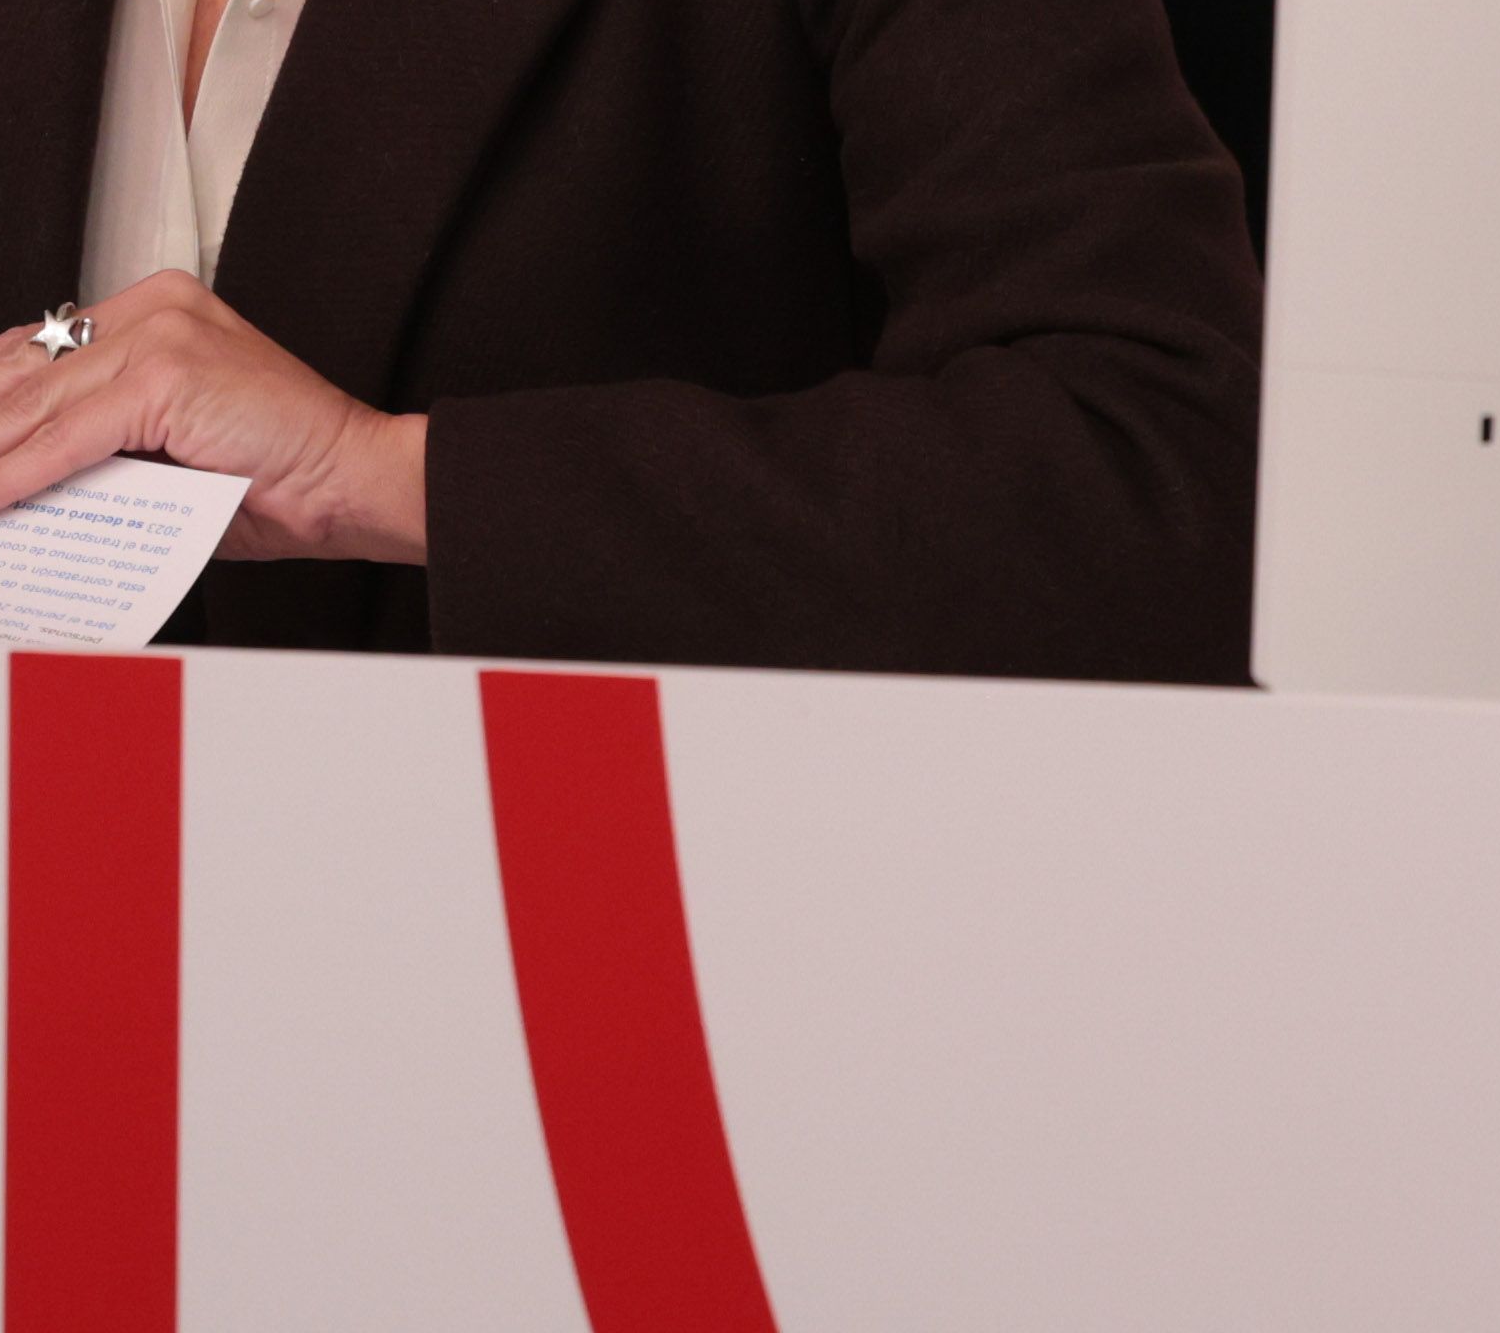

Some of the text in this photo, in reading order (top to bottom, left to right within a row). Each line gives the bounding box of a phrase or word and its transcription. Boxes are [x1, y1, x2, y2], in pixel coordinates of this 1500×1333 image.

[44, 482, 194, 517] lo que se ha tenido qu
[11, 500, 65, 517] desiert
[69, 510, 123, 526] declaró
[127, 520, 144, 529] se
[146, 523, 182, 538] 2023
[32, 526, 50, 536] de
[52, 529, 121, 548] transporte
[29, 546, 47, 557] de
[122, 541, 137, 551] el
[140, 544, 171, 556] para
[48, 550, 106, 565] continuo
[10, 563, 28, 572] en
[31, 567, 113, 587] contratación
[0, 580, 18, 589] de
[117, 581, 146, 593] esta
[22, 584, 117, 606] procedimiento
[118, 602, 133, 611] El
[0, 619, 30, 631] Todo
[84, 619, 116, 631] para
[40, 627, 103, 644] personas.
